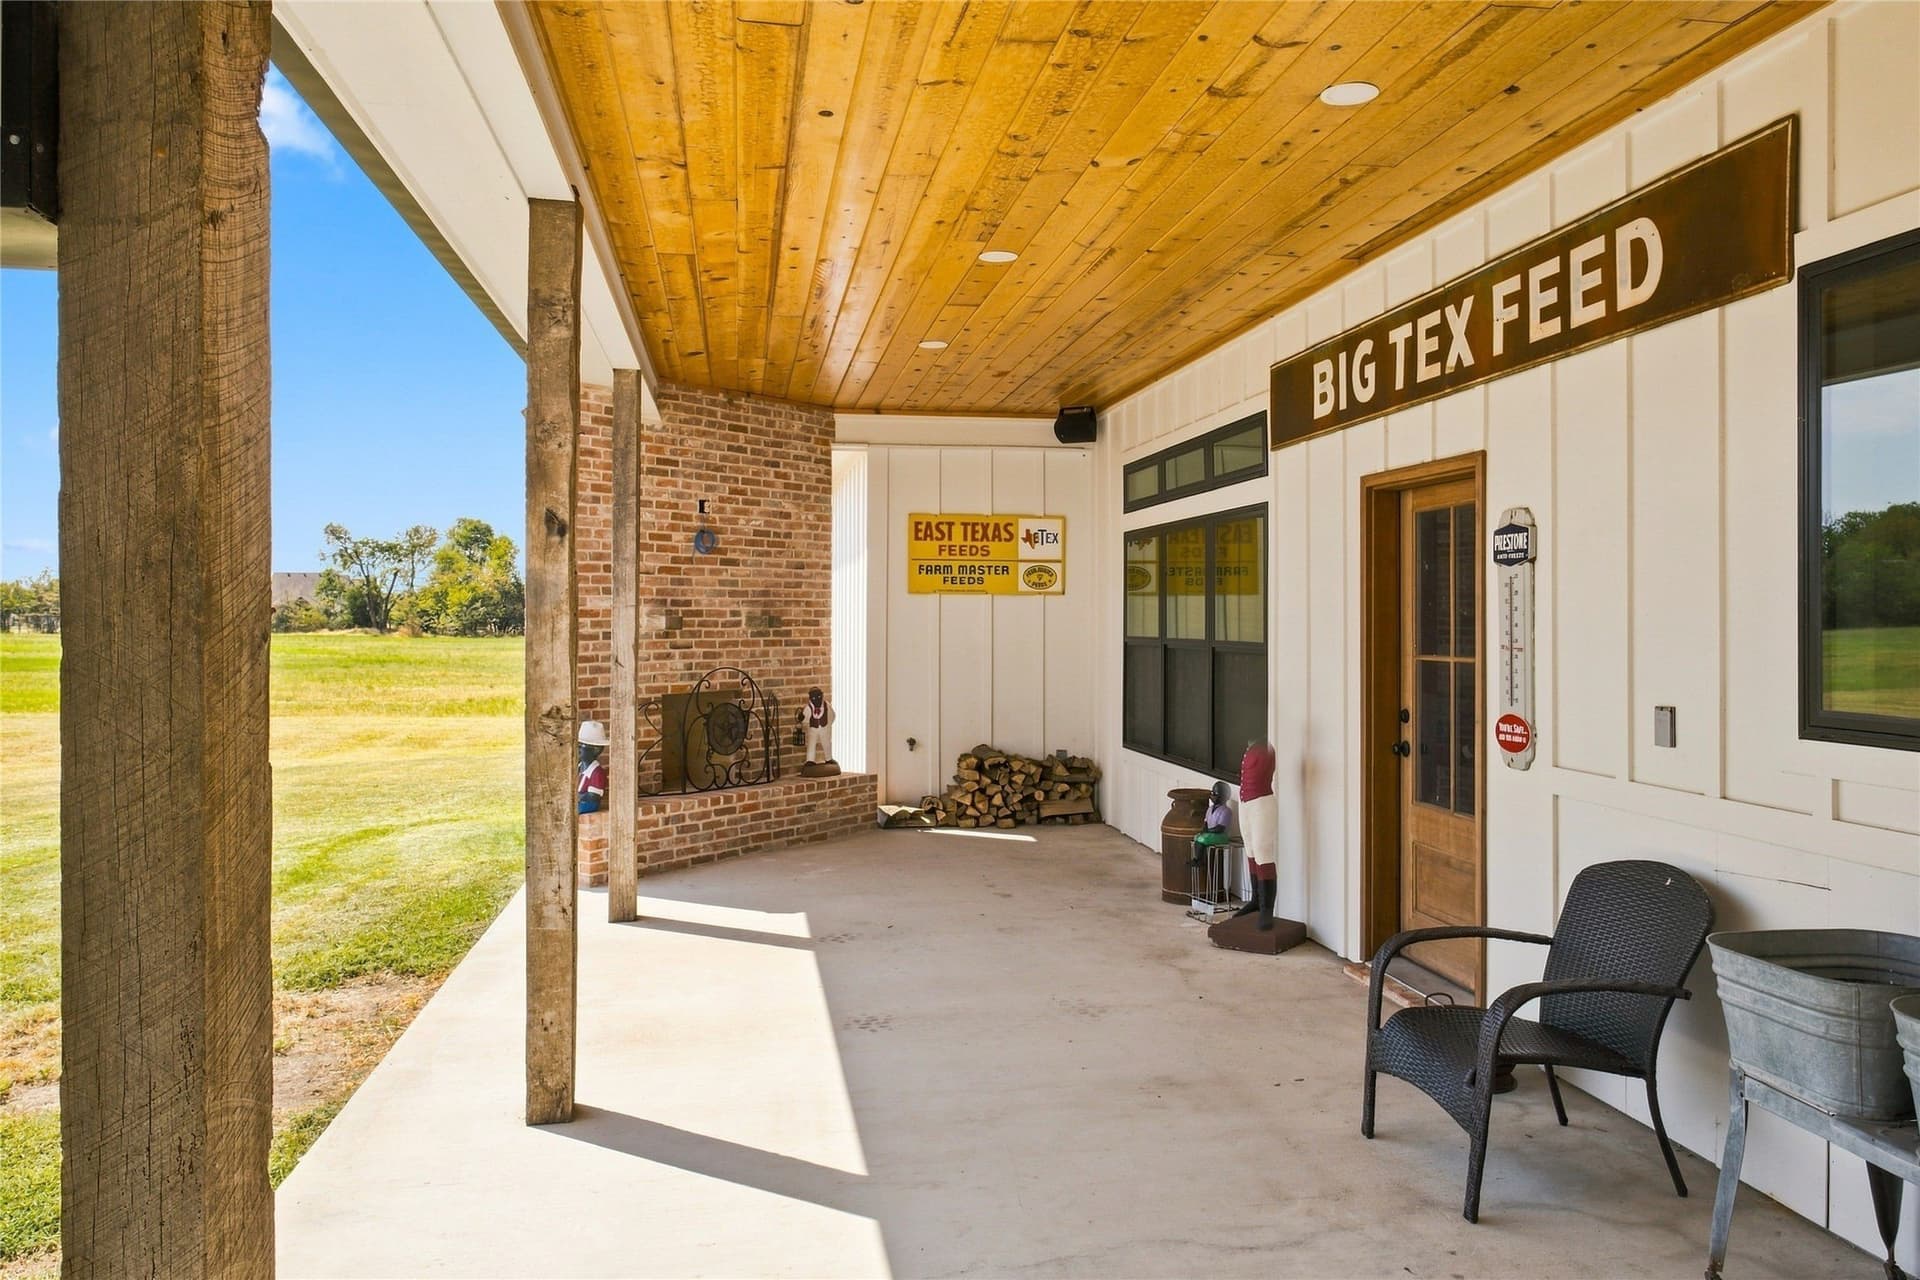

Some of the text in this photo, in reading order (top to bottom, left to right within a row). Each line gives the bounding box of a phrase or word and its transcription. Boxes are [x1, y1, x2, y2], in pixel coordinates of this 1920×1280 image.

[1313, 217, 1664, 420] BIG TEX FEED
[914, 521, 1014, 542] EAST TEXAS
[1494, 532, 1528, 551] PRESTONE
[938, 545, 990, 556] FEEDS
[918, 565, 1010, 575] FARM MASTER
[943, 577, 984, 585] FEEDS
